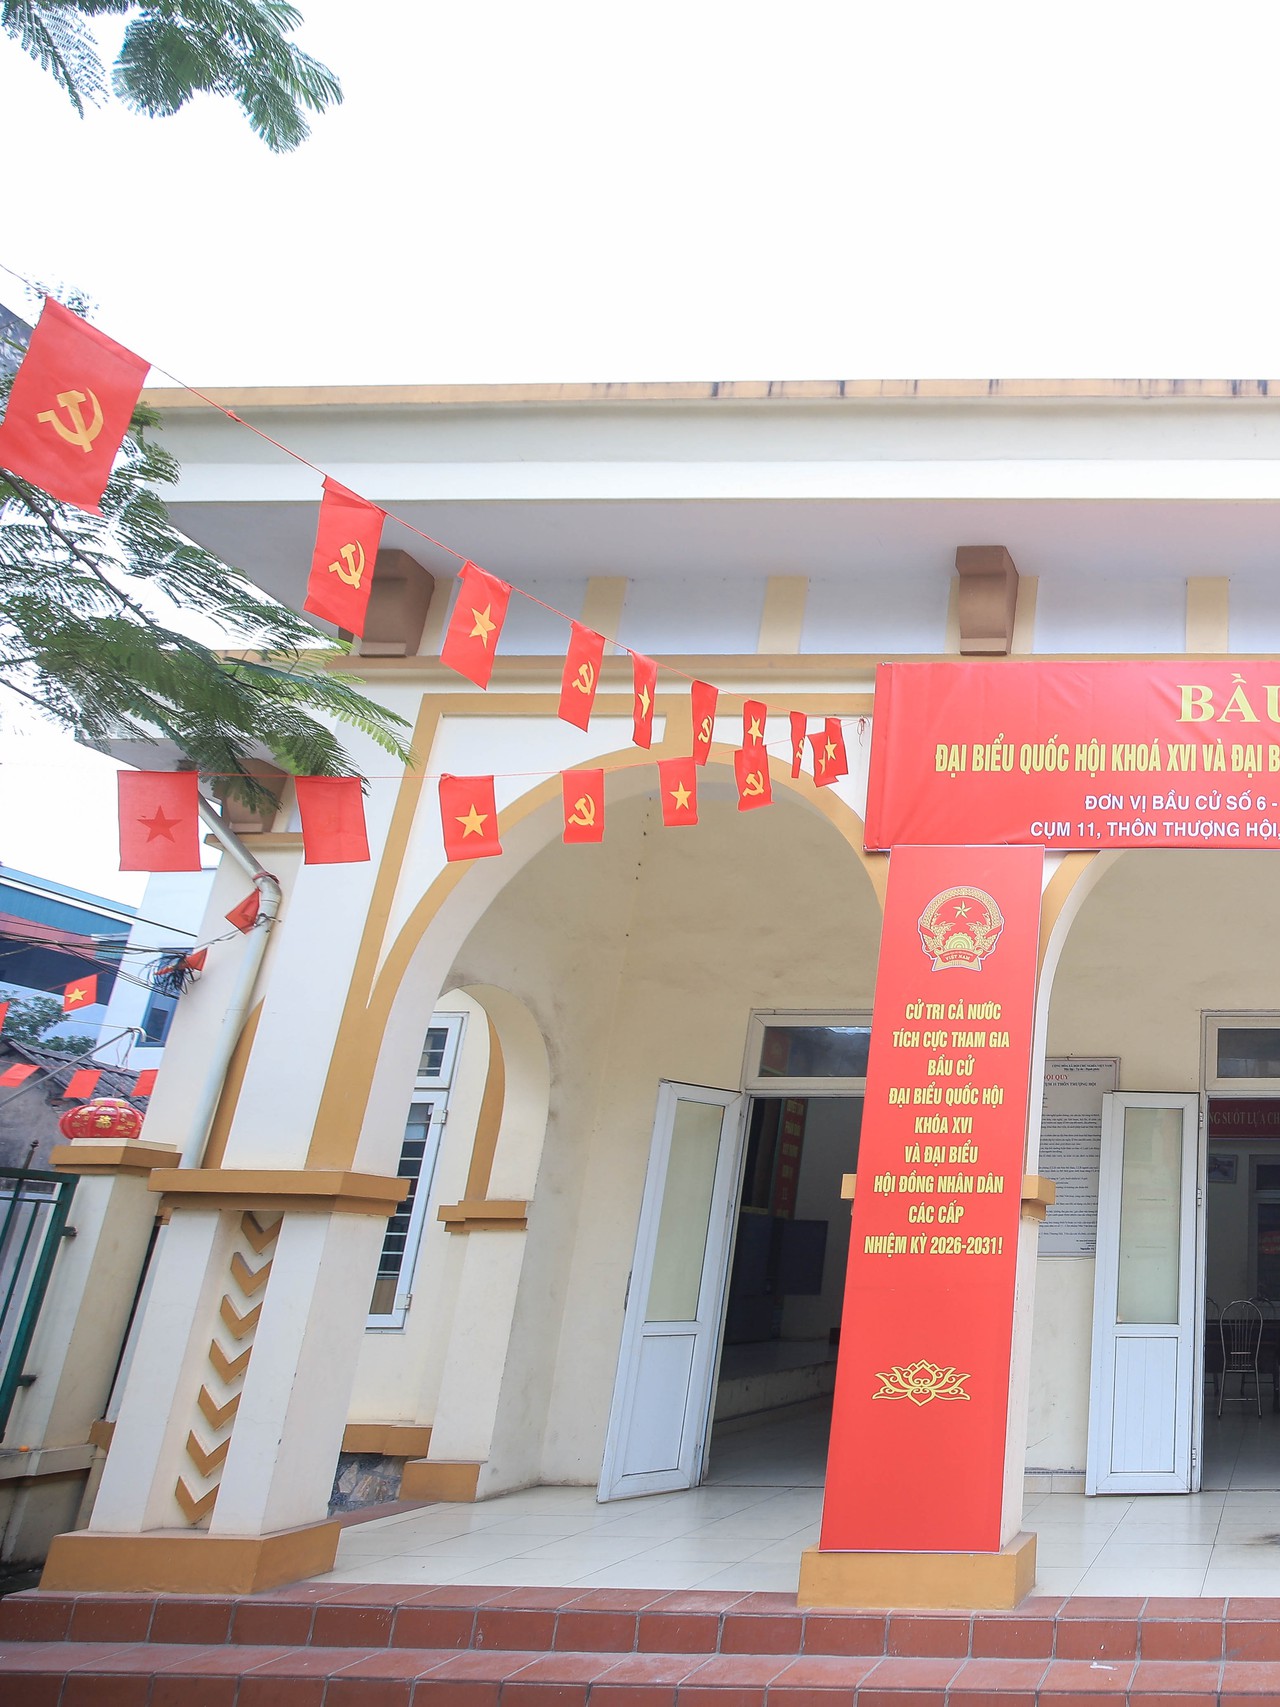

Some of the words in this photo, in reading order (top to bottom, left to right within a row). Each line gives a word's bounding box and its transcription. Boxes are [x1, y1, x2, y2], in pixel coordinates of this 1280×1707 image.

[935, 745, 967, 777] ĐẠI
[972, 733, 1014, 771] BIỂU
[1020, 735, 1069, 774] QUỐC
[1075, 738, 1105, 777] HỘI
[1112, 738, 1161, 771] KHOÁ
[1167, 744, 1196, 771] XVI
[1202, 738, 1226, 771] VÀ
[1231, 745, 1262, 778] ĐẠI
[1085, 794, 1123, 809] ĐƠN
[1130, 796, 1145, 812] VỊ
[1153, 790, 1189, 810] BẦU
[1196, 790, 1221, 810] CỬ
[1227, 790, 1251, 810] SỐ
[1257, 796, 1266, 810] 6
[1031, 822, 1070, 839] CỤM
[1078, 823, 1100, 839] 11,
[1107, 818, 1156, 837] THÔN
[1162, 820, 1239, 840] THƯỢNG
[1247, 819, 1280, 840] HỘI,
[906, 999, 925, 1020] CỬ
[926, 1004, 944, 1019] TRI
[948, 999, 964, 1019] CẢ
[968, 1001, 1001, 1019] NƯỚC
[893, 1028, 920, 1047] TÍCH
[923, 1030, 947, 1051] CỰC
[952, 1032, 985, 1047] THAM
[989, 1032, 1009, 1047] GIA
[928, 1054, 953, 1075] BẦU
[957, 1055, 975, 1075] CỬ
[889, 1088, 910, 1107] ĐẠI
[914, 1082, 942, 1104] BIỂU
[946, 1083, 978, 1106] QUỐC
[982, 1085, 1003, 1108] HỘI
[915, 1114, 948, 1133] KHÓA
[952, 1117, 972, 1133] XVI
[905, 1143, 920, 1162] VÀ
[924, 1146, 945, 1166] ĐẠI
[949, 1140, 978, 1163] BIỂU
[874, 1172, 895, 1196] HỘI
[899, 1170, 934, 1192] ĐỒNG
[938, 1173, 973, 1192] NHÂN
[977, 1173, 1003, 1193] DÂN
[909, 1202, 934, 1223] CÁC
[938, 1200, 964, 1223] CẤP
[865, 1233, 907, 1257] NHIỆM
[910, 1233, 927, 1253] KỲ
[930, 1237, 1002, 1254] 2026-2031!
